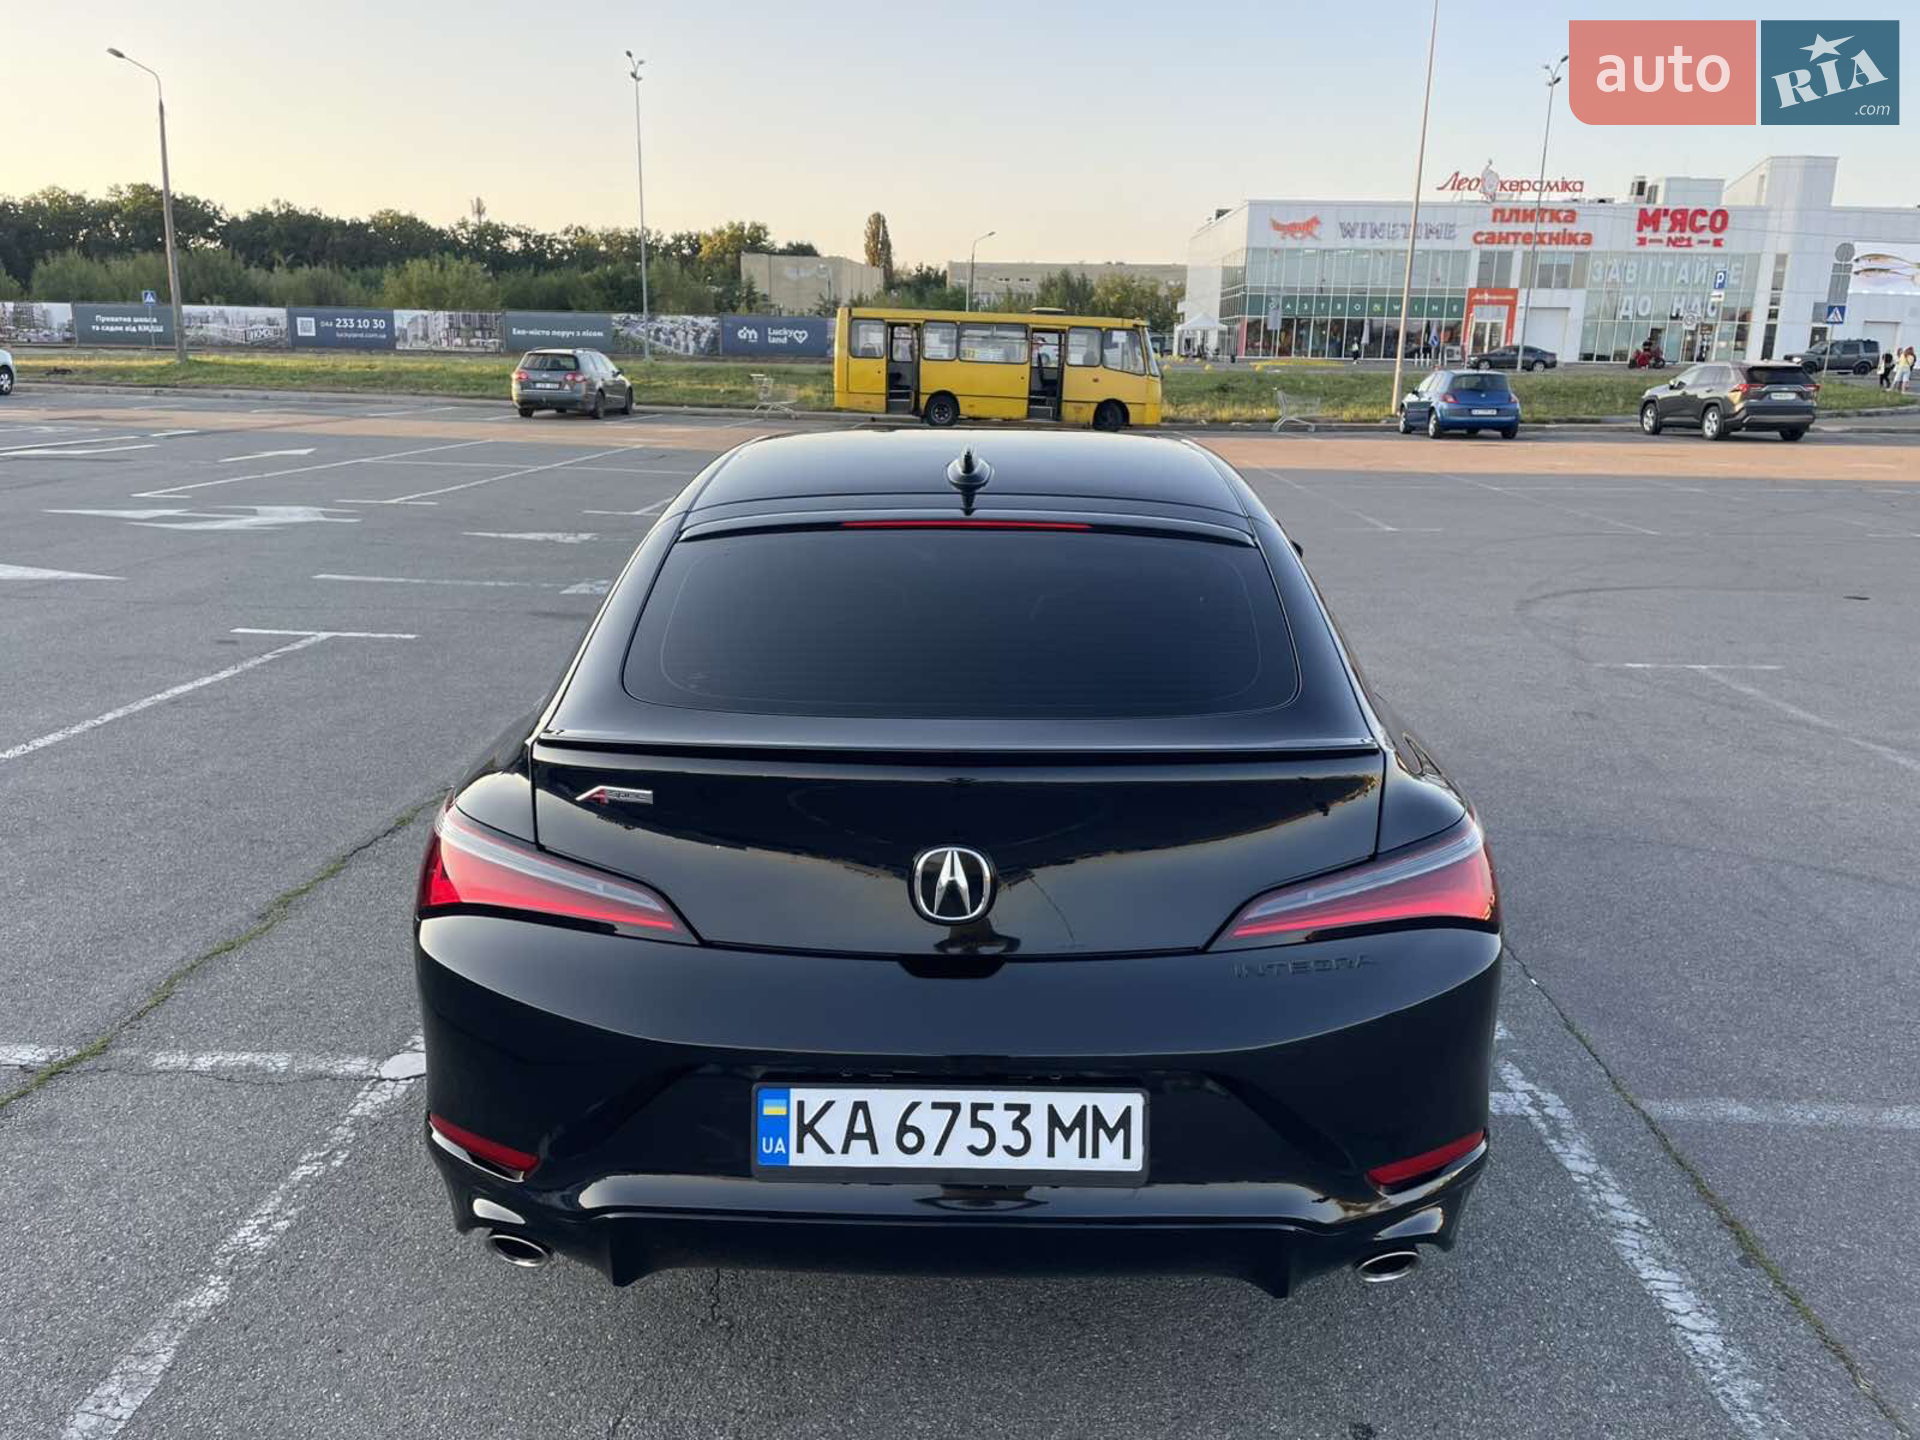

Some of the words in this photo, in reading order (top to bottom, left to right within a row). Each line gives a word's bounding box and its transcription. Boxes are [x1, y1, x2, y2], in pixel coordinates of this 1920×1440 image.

[1436, 171, 1481, 191] Лео
[1499, 176, 1584, 194] кераміка
[1636, 208, 1729, 233] М'ЯСО
[1339, 221, 1457, 240] WINETIME
[1472, 228, 1593, 245] сантехніка
[1715, 272, 1725, 289] P
[1619, 294, 1651, 320] ДО
[335, 318, 355, 328] 233
[357, 318, 370, 329] 10
[372, 319, 386, 329] 30
[768, 327, 793, 337] Lucky
[551, 329, 575, 338] поруч
[762, 1137, 785, 1154] UA
[796, 1100, 879, 1155] KA
[895, 1101, 1031, 1158] 6753
[1047, 1103, 1131, 1159] MM
